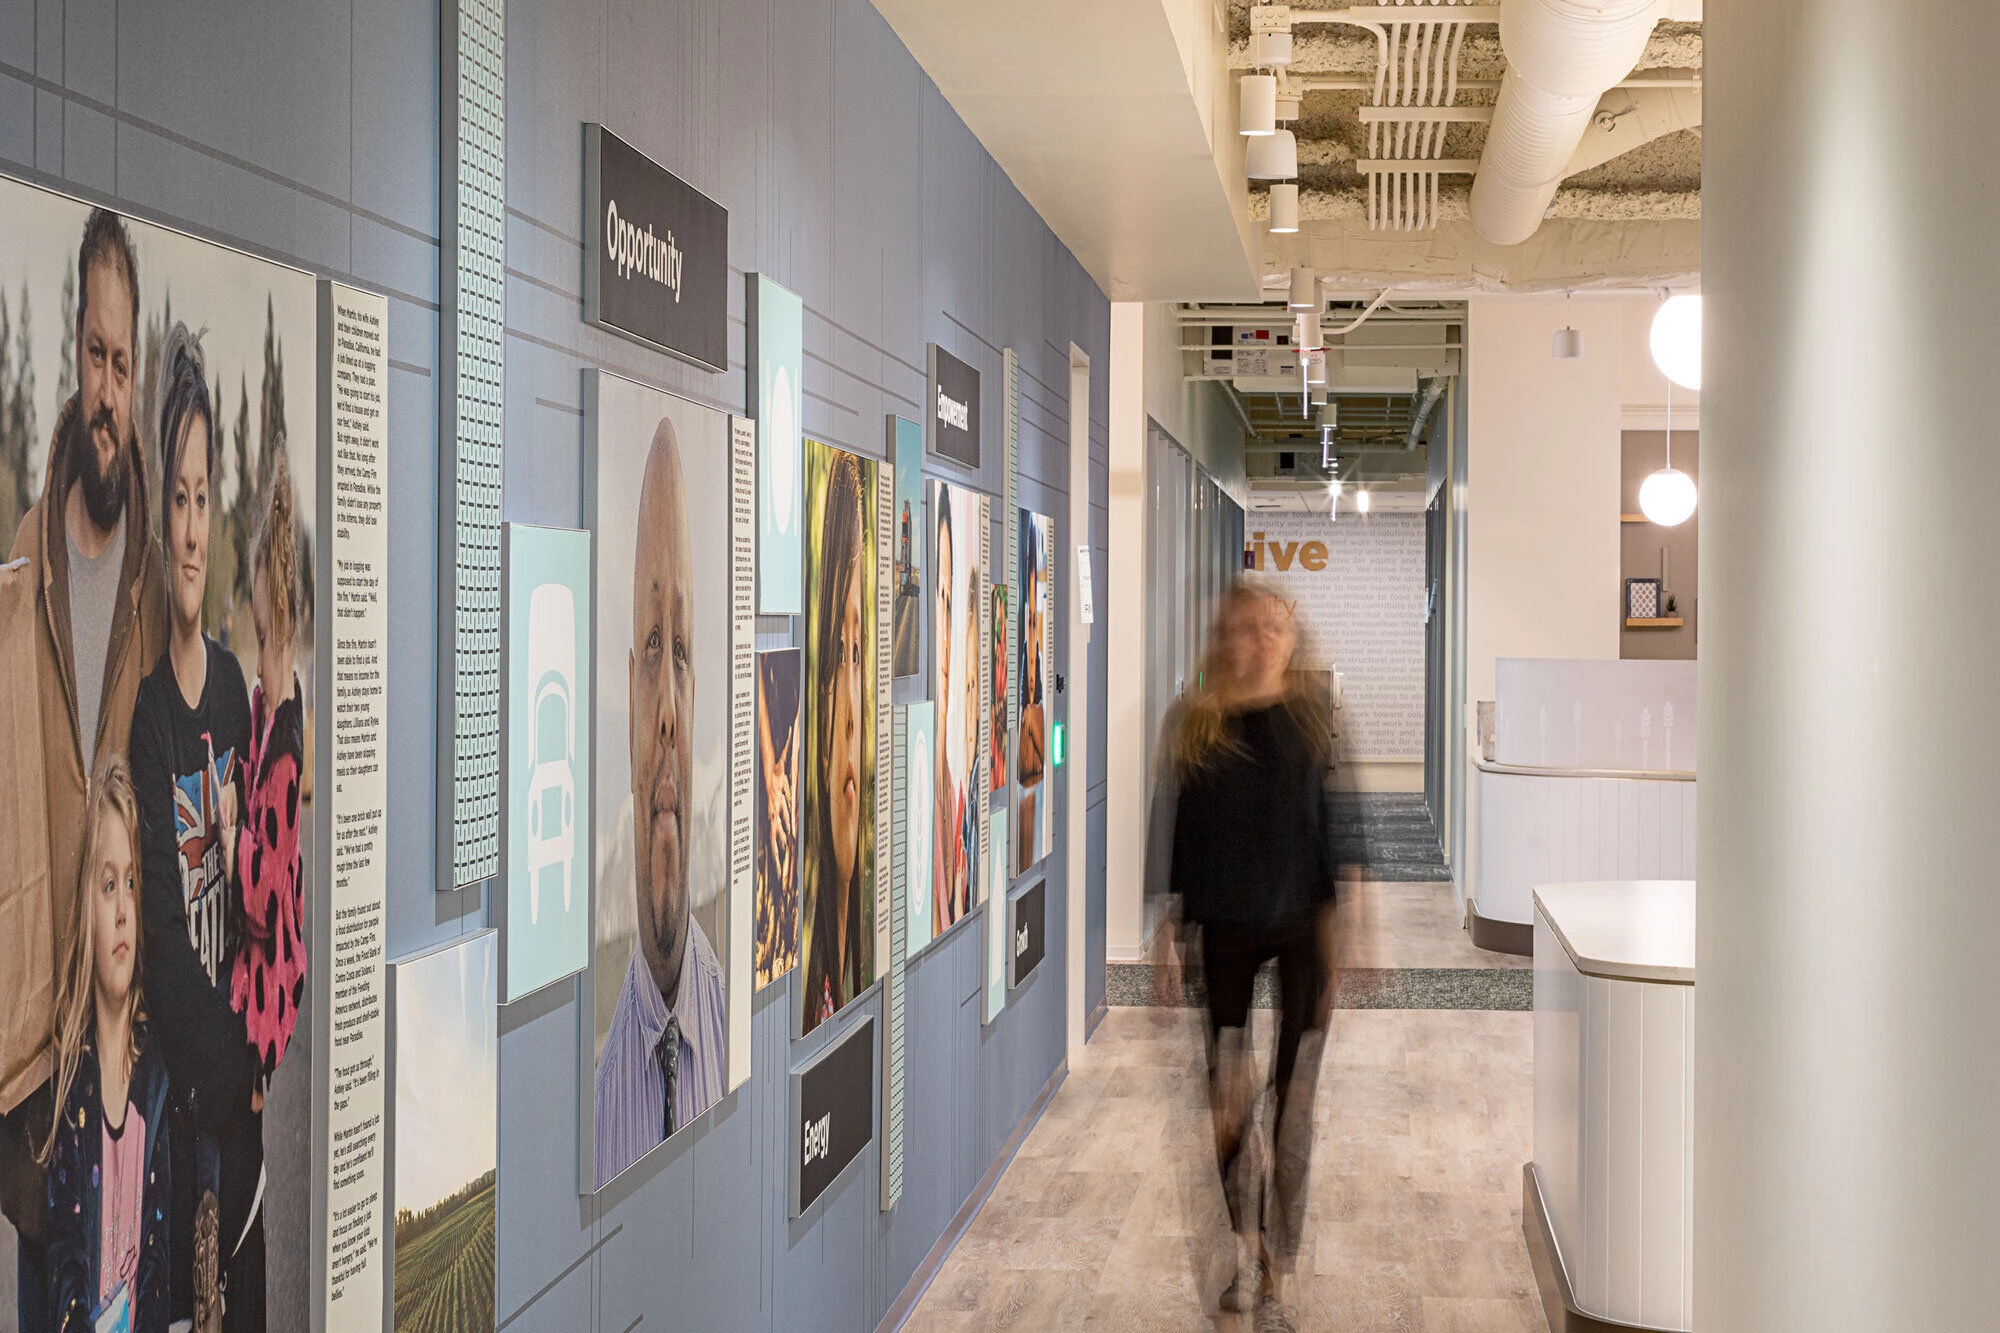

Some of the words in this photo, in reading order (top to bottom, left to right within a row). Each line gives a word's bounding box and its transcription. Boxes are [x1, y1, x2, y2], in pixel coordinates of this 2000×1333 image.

[607, 200, 683, 303] Opportunity
[1258, 520, 1284, 530] equity
[1277, 530, 1303, 539] equity
[1246, 531, 1328, 571] ive
[1336, 549, 1362, 557] equity
[202, 841, 219, 890] THE
[804, 1112, 831, 1166] Energy
